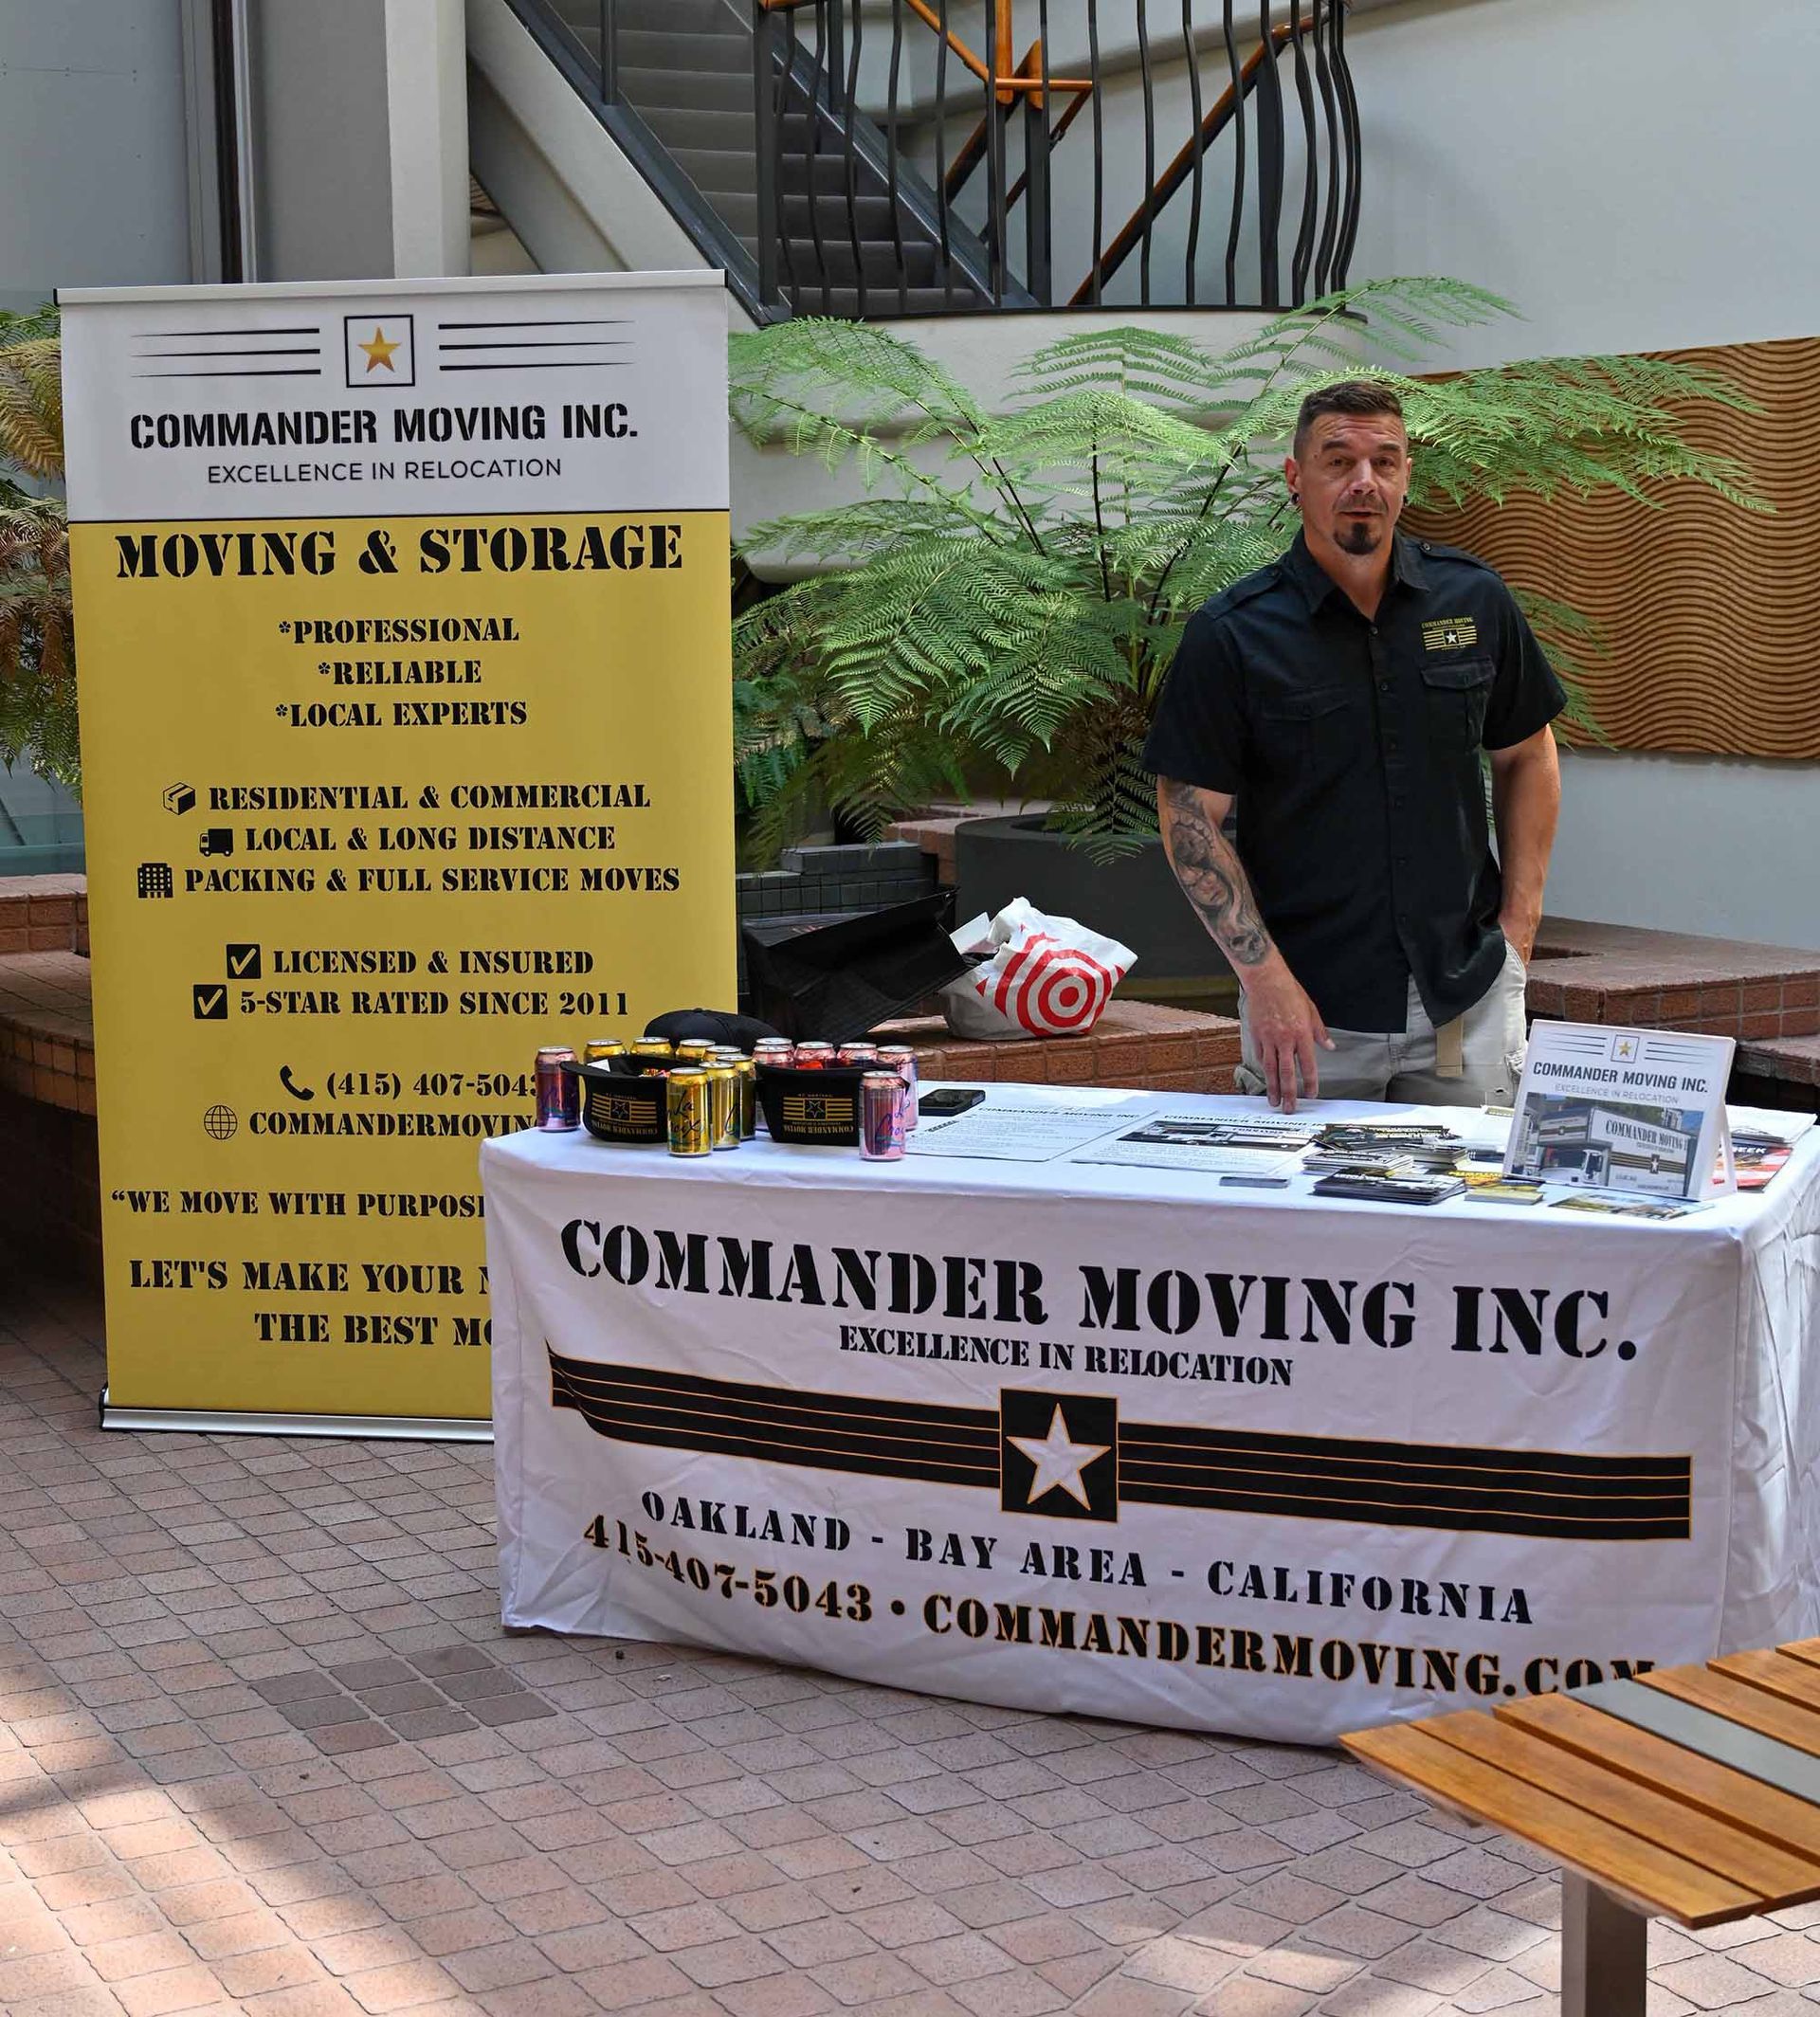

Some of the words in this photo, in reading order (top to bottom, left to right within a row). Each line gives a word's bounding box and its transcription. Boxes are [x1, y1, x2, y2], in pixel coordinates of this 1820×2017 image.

[130, 409, 377, 449] COMMANDER
[393, 405, 546, 443] MOVING
[562, 403, 638, 439] INC.
[208, 463, 363, 484] EXCELLENCE
[372, 462, 394, 481] IN
[405, 458, 561, 480] RELOCATION
[114, 531, 336, 578] MOVING
[358, 529, 399, 575] &
[419, 524, 682, 573] STORAGE
[392, 700, 527, 726] EXPERTS
[209, 786, 409, 810] RESIDENTIAL
[418, 785, 441, 809] &
[450, 784, 651, 809] COMMERCIAL
[246, 827, 337, 851] LOCAL
[347, 827, 369, 851] &
[378, 827, 457, 851] LONG
[467, 826, 615, 850] DISTANCE
[184, 868, 316, 892] PACKING
[326, 868, 348, 892] &
[357, 868, 432, 892] FULL
[442, 867, 569, 892] SERVICE
[579, 867, 680, 892] MOVES
[273, 950, 417, 974] LICENSED
[428, 950, 449, 974] &
[459, 951, 593, 974] INSURED
[240, 990, 341, 1014] 5-STAR
[351, 991, 449, 1015] RATED
[459, 991, 548, 1015] SINCE
[559, 991, 628, 1016] 2011
[326, 1072, 401, 1100] (415)
[1533, 1062, 1618, 1083] COMMANDER
[1622, 1071, 1678, 1090] MOVING
[1682, 1077, 1708, 1093] INC.
[1622, 1090, 1680, 1105] RELOCATION
[1606, 1119, 1658, 1144] COMMANDER
[179, 1190, 259, 1214] MOVE
[268, 1191, 347, 1216] WITH
[129, 1260, 228, 1290] LET'S
[242, 1262, 349, 1292] MAKE
[360, 1263, 464, 1295] YOUR
[561, 1219, 1049, 1326] COMMANDER
[1079, 1265, 1415, 1349] MOVING
[1451, 1285, 1638, 1361] INC.
[254, 1313, 330, 1343] THE
[343, 1315, 439, 1345] BEST
[840, 1325, 1029, 1368] EXCELLENCE
[1039, 1342, 1074, 1372] IN
[1083, 1345, 1292, 1387] RELOCATION
[583, 1513, 872, 1623] 415-407-5043
[641, 1491, 850, 1552] OAKLAND
[905, 1527, 997, 1570] BAY
[1020, 1542, 1147, 1587] AREA
[1207, 1559, 1533, 1625] CALIFORNIA
